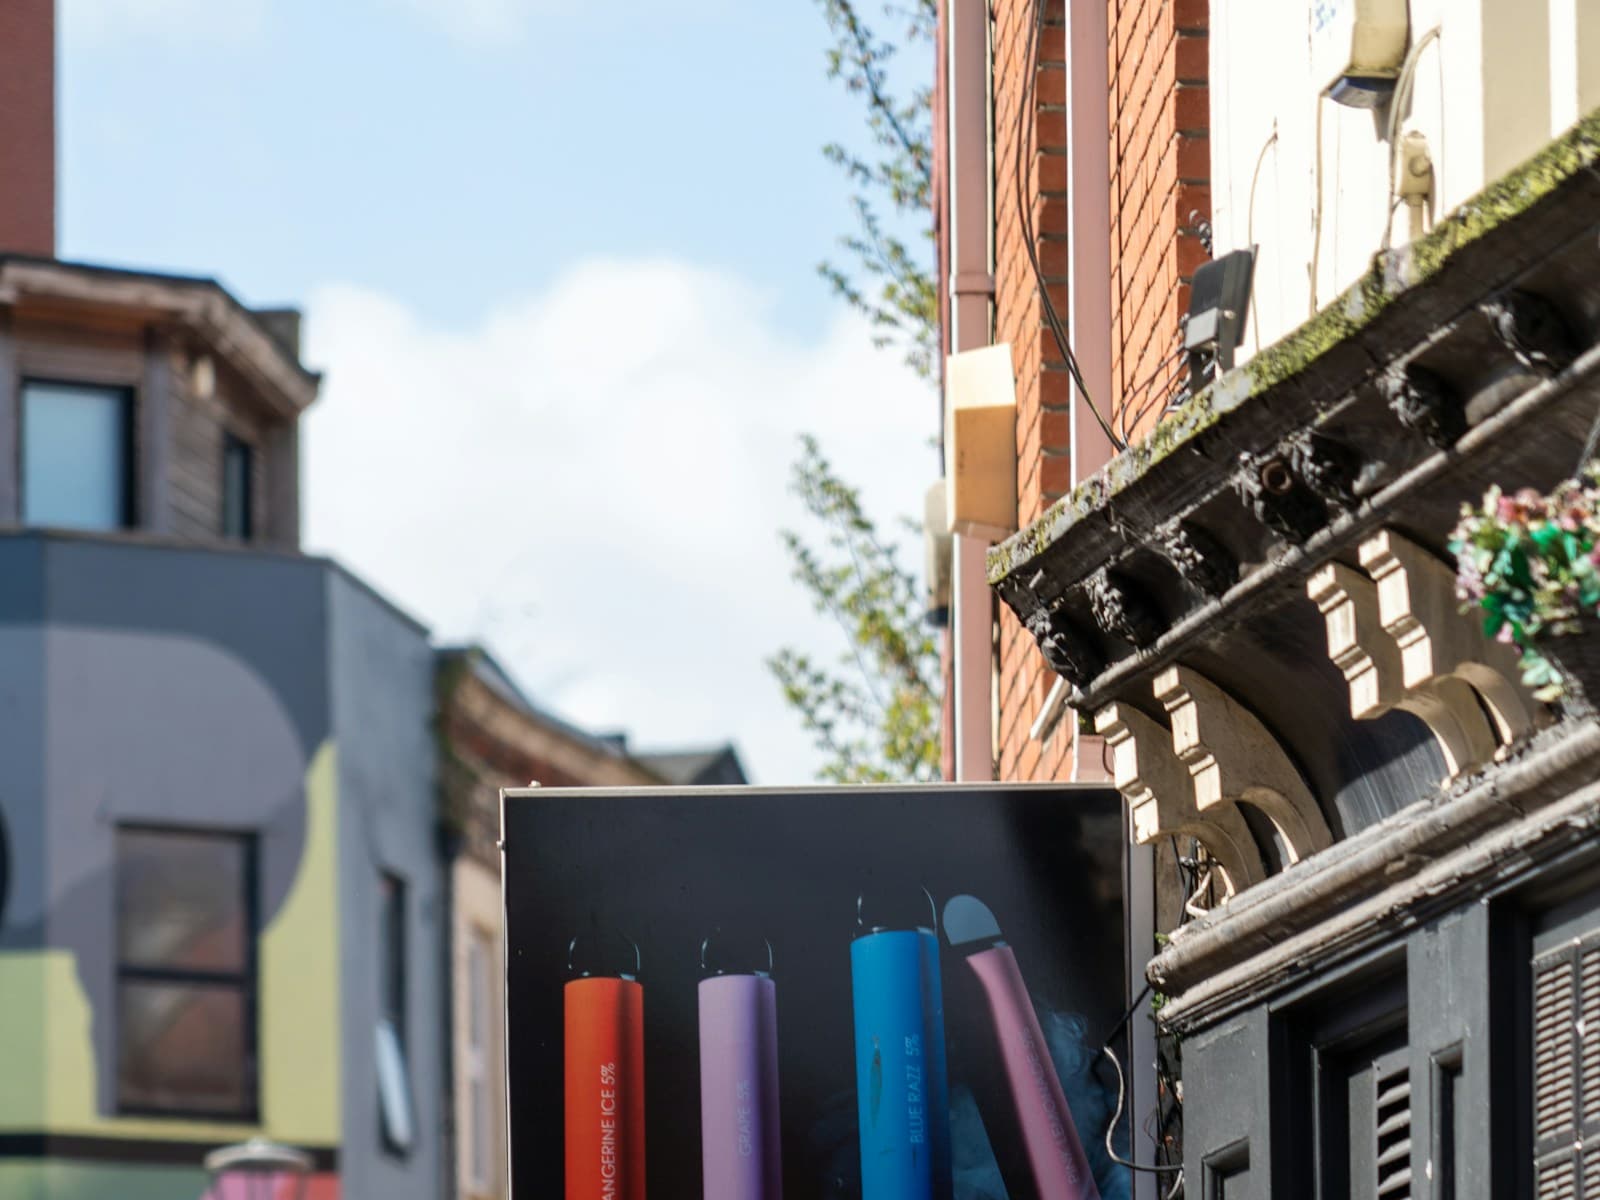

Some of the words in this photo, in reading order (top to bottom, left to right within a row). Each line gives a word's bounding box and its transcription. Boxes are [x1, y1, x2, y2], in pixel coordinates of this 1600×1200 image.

[904, 1033, 920, 1057] 5%
[600, 1062, 616, 1085] 5%
[906, 1063, 921, 1103] RAZZ
[600, 1089, 616, 1116] ICE
[736, 1106, 753, 1158] GRAPE
[908, 1104, 924, 1144] BLUE
